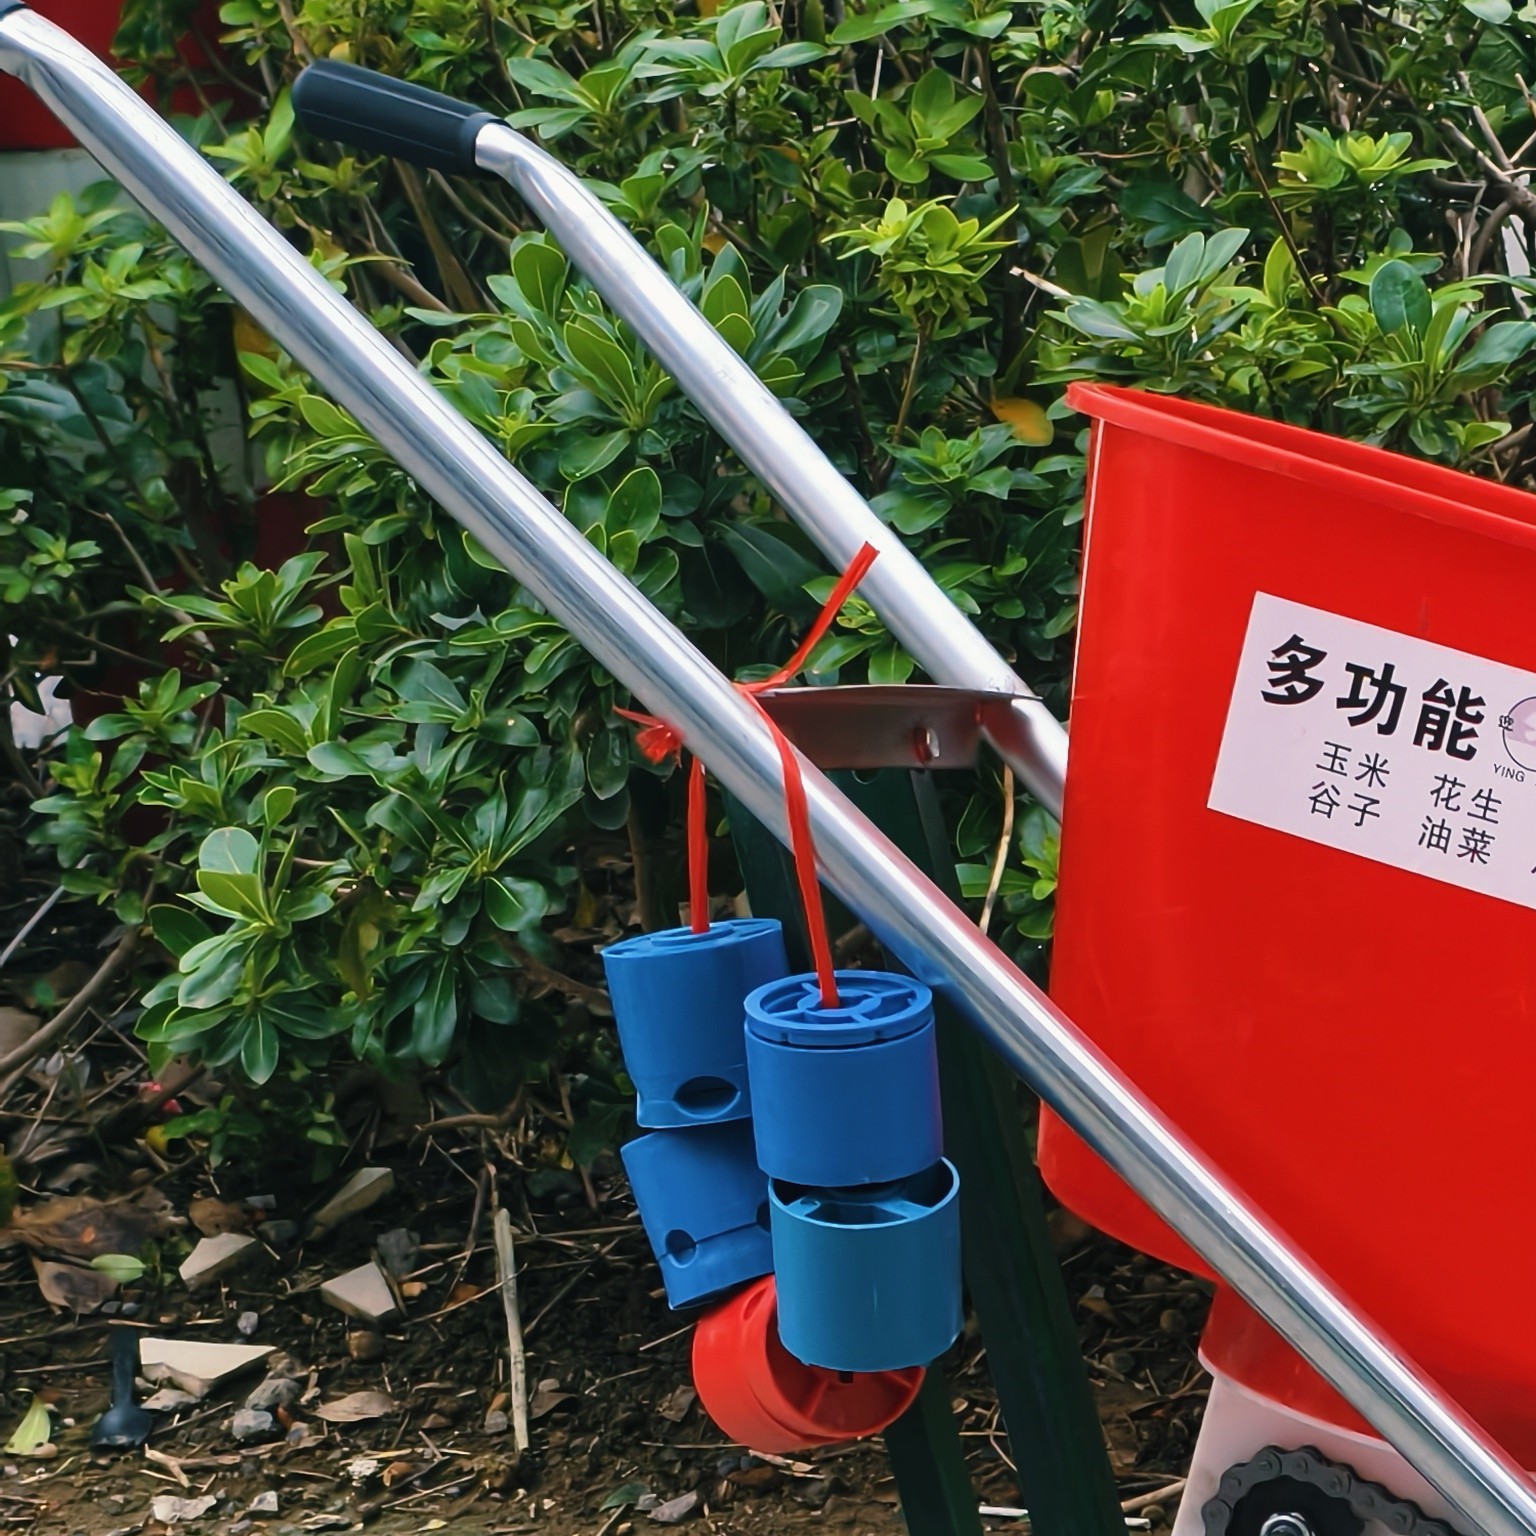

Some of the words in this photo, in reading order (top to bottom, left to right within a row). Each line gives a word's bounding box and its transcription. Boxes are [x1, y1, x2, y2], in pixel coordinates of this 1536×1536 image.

[1260, 633, 1487, 762] 多功能
[1315, 740, 1391, 788] 玉米
[1429, 773, 1502, 825] 花生
[1493, 763, 1526, 783] YING
[1308, 780, 1381, 827] 谷子
[1417, 815, 1496, 865] 油菜
